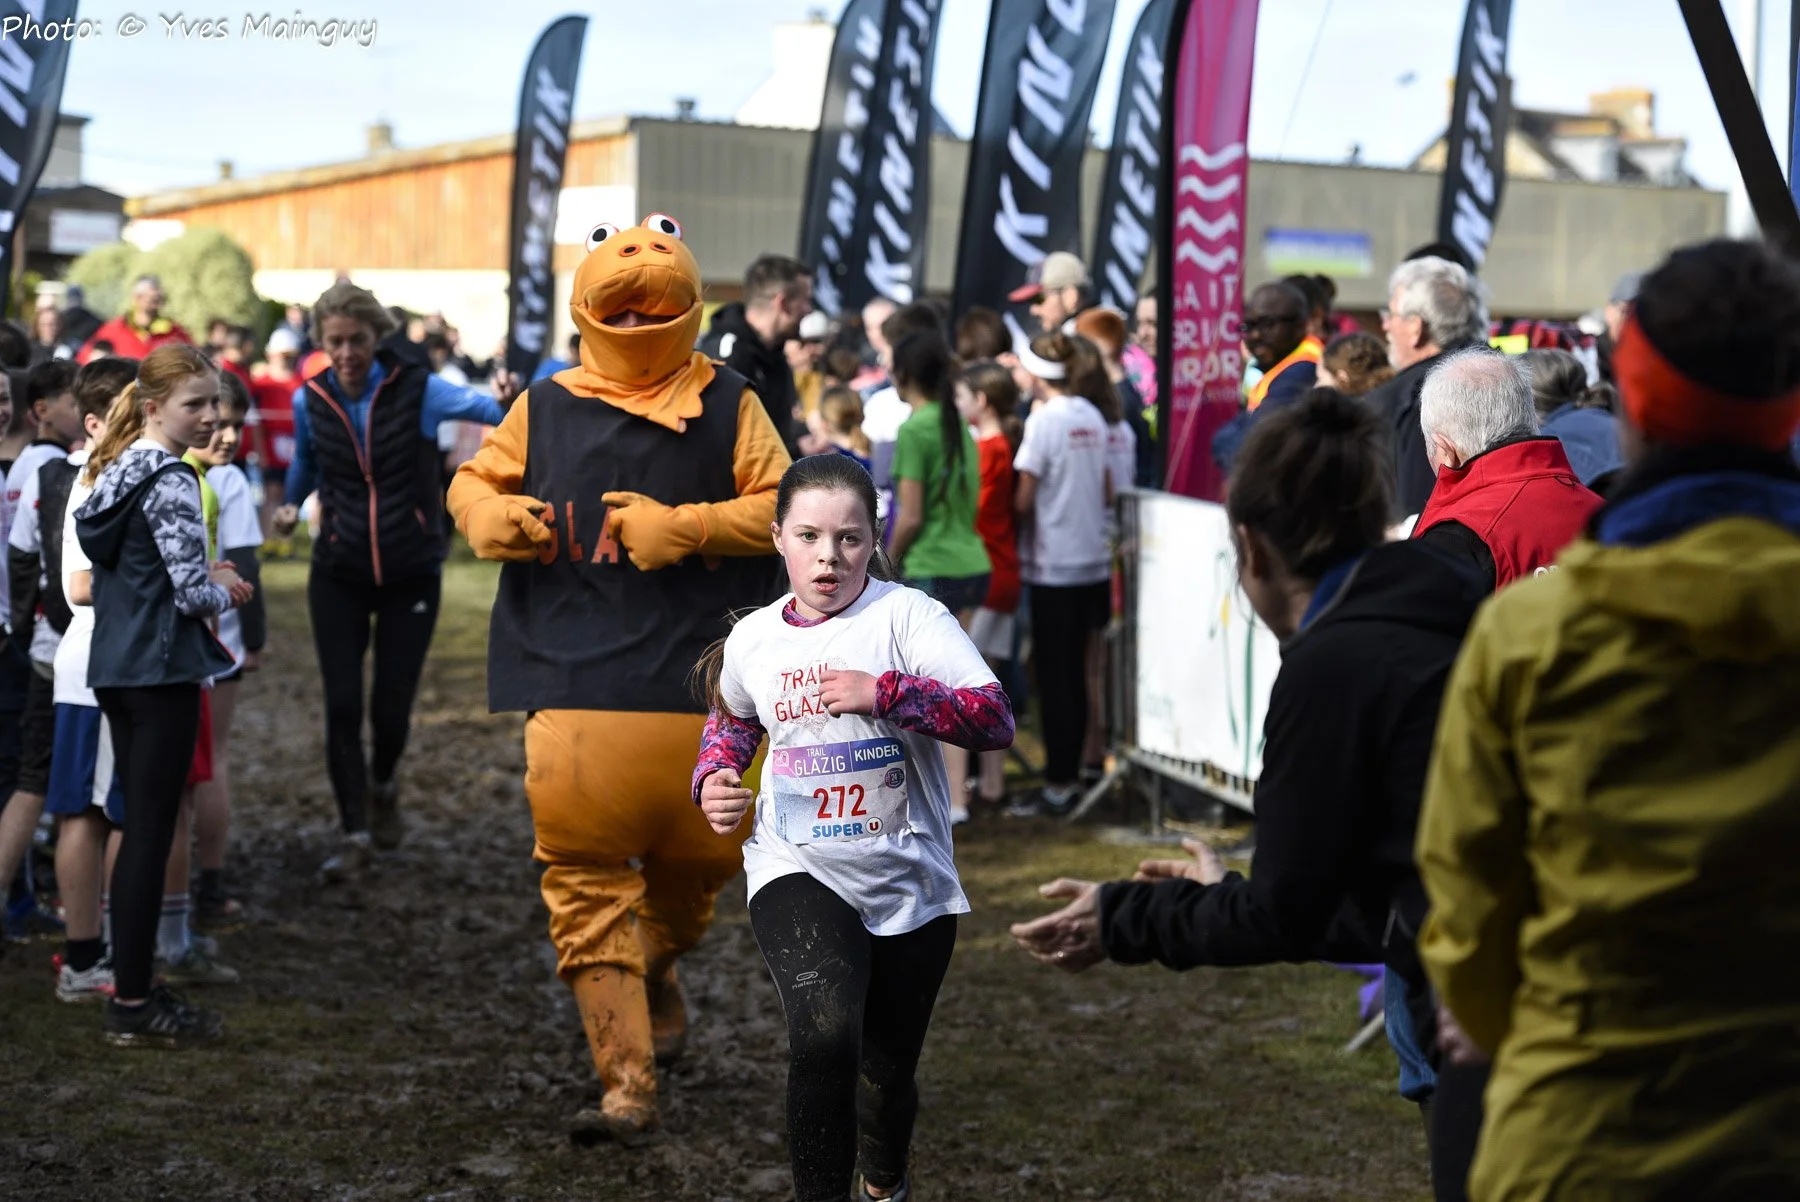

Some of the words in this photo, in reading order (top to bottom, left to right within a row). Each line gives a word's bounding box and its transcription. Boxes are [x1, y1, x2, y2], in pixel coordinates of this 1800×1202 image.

[538, 500, 620, 567] GLA
[775, 693, 825, 722] GLAZ
[806, 748, 826, 758] TRAIL
[854, 744, 900, 762] KINDER
[794, 755, 846, 776] GLAZIG
[813, 784, 867, 819] 272
[811, 822, 863, 838] SUPER
